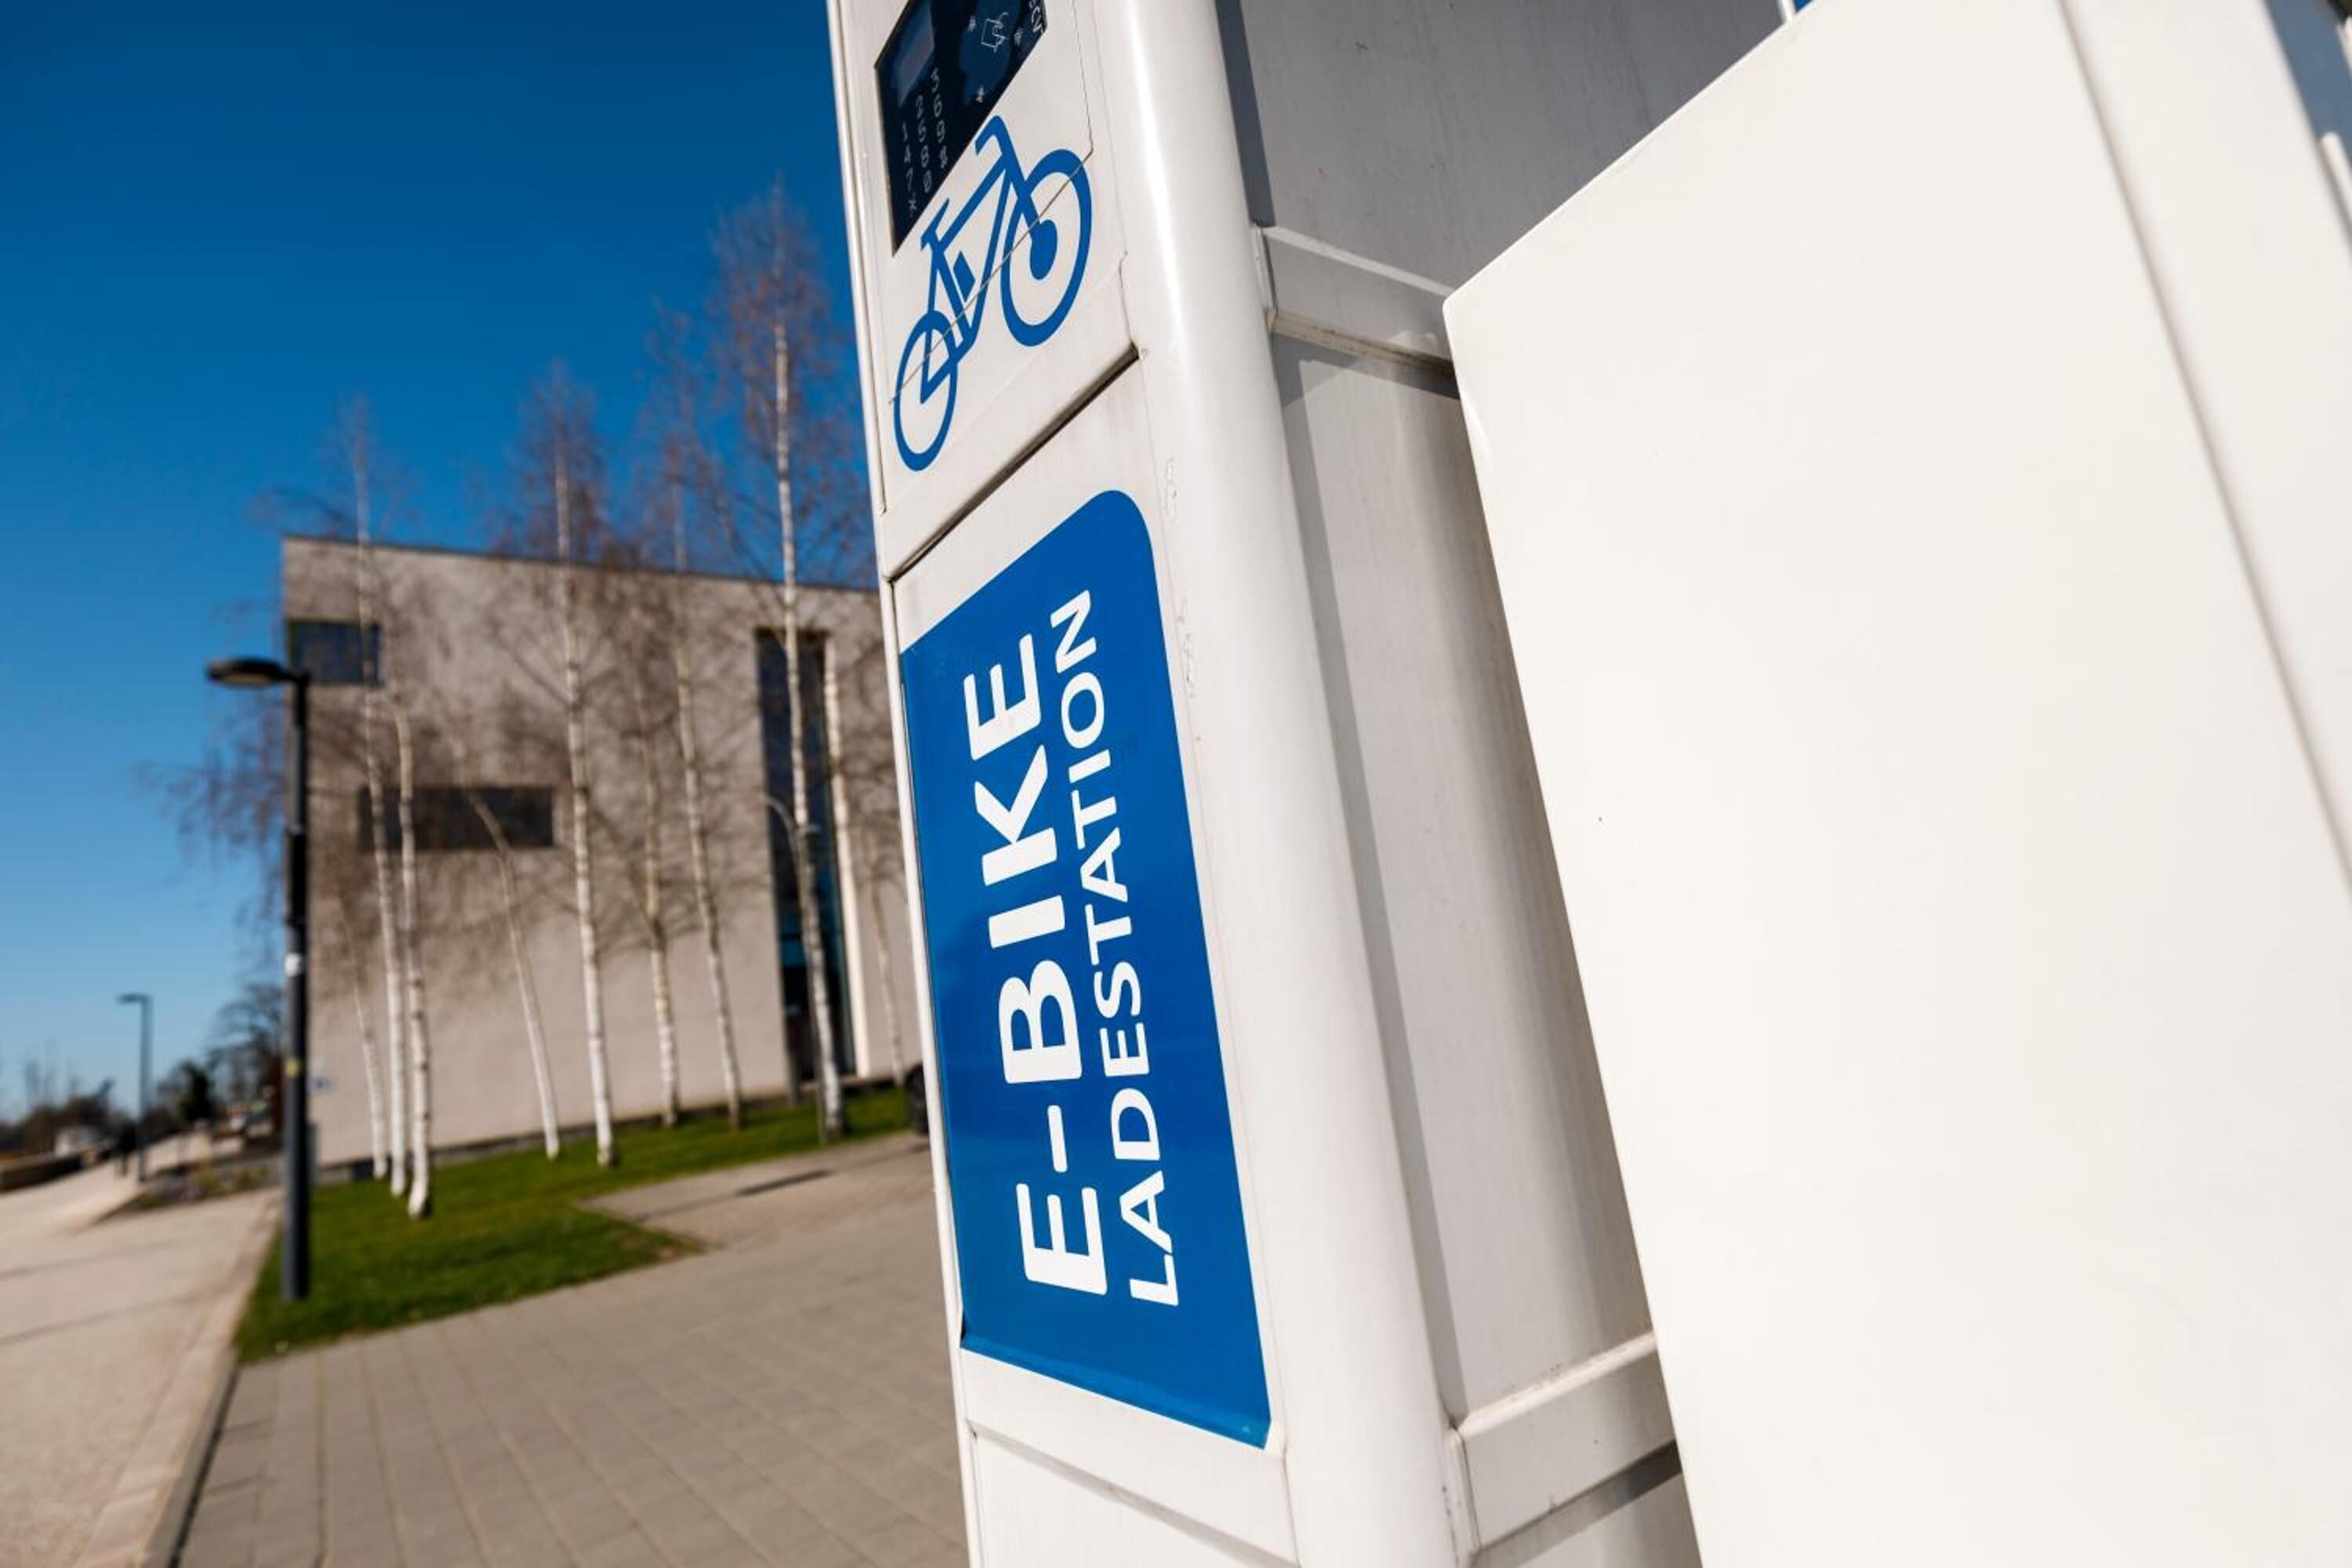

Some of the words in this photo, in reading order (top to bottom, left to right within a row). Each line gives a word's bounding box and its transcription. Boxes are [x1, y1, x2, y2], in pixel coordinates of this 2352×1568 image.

[916, 95, 924, 118] 2
[934, 94, 942, 118] 6
[964, 635, 1107, 1295] E-BIKE
[1051, 590, 1178, 1306] LADESTATION
